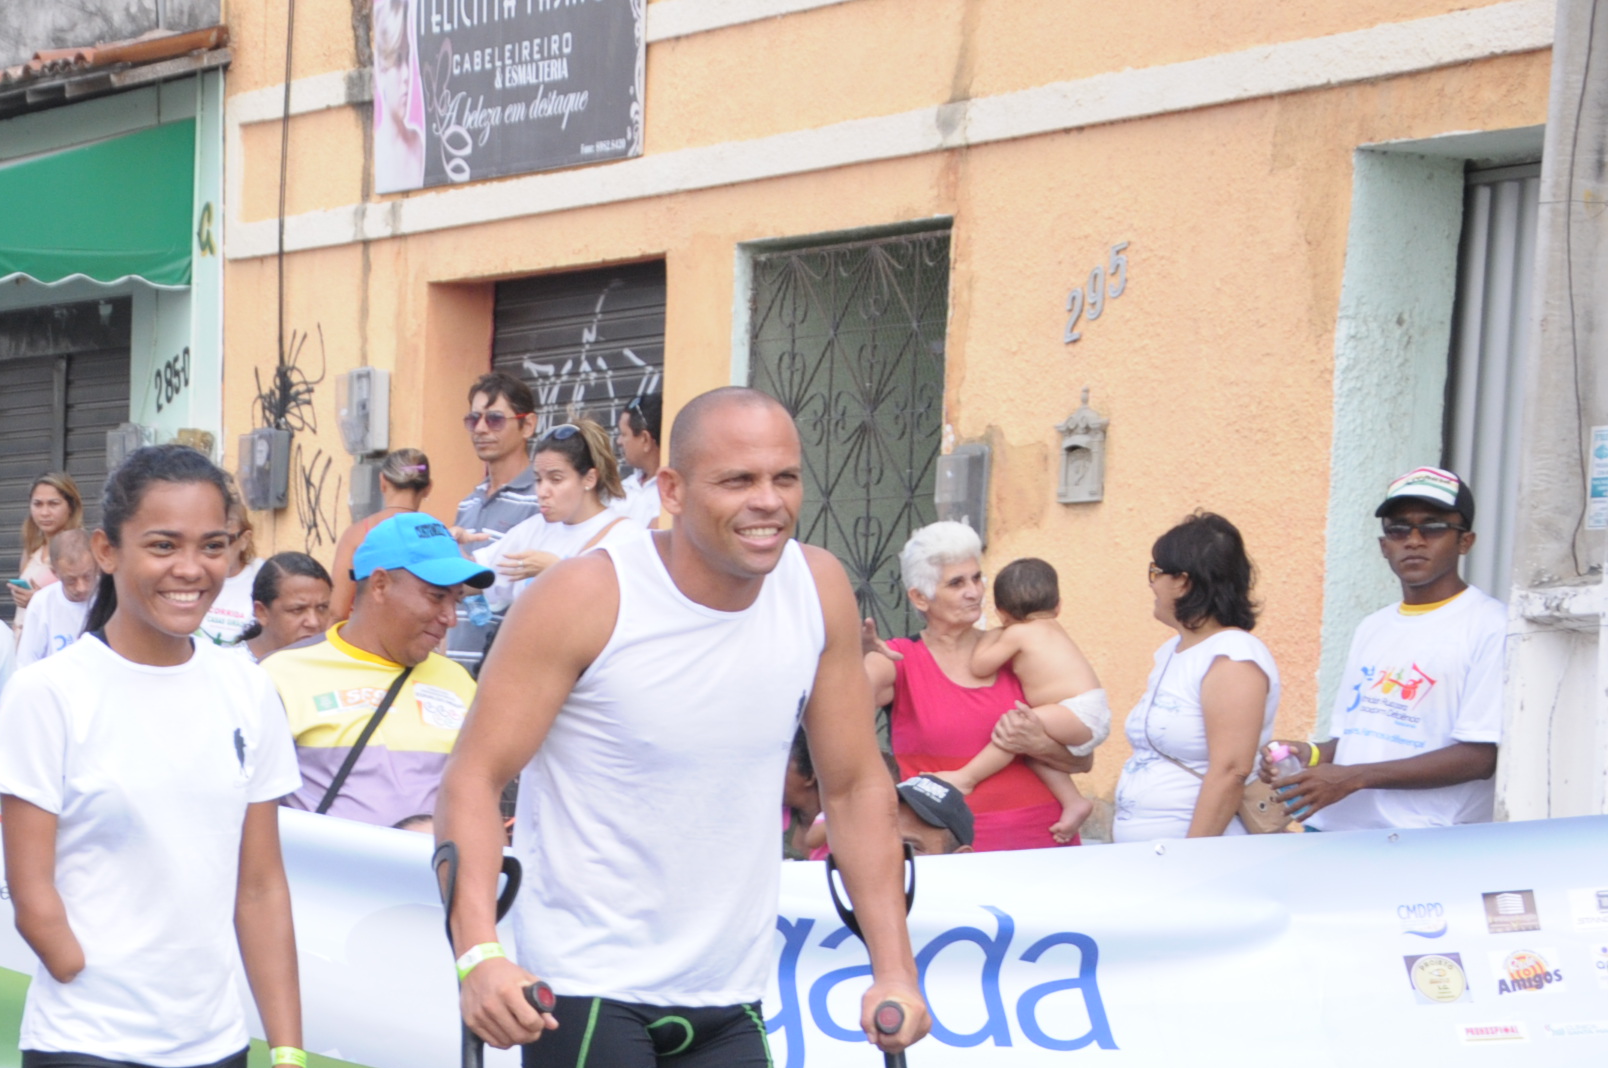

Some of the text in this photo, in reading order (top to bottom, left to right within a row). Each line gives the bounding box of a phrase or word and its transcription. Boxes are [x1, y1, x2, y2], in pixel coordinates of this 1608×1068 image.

[452, 32, 573, 75] CABELEIREIRO
[494, 57, 569, 89] & ESMALTERIA
[463, 95, 502, 147] beleza
[504, 102, 527, 123] em
[529, 84, 589, 131] destaque
[1063, 240, 1129, 344] 295
[1498, 968, 1563, 996] Amigos
